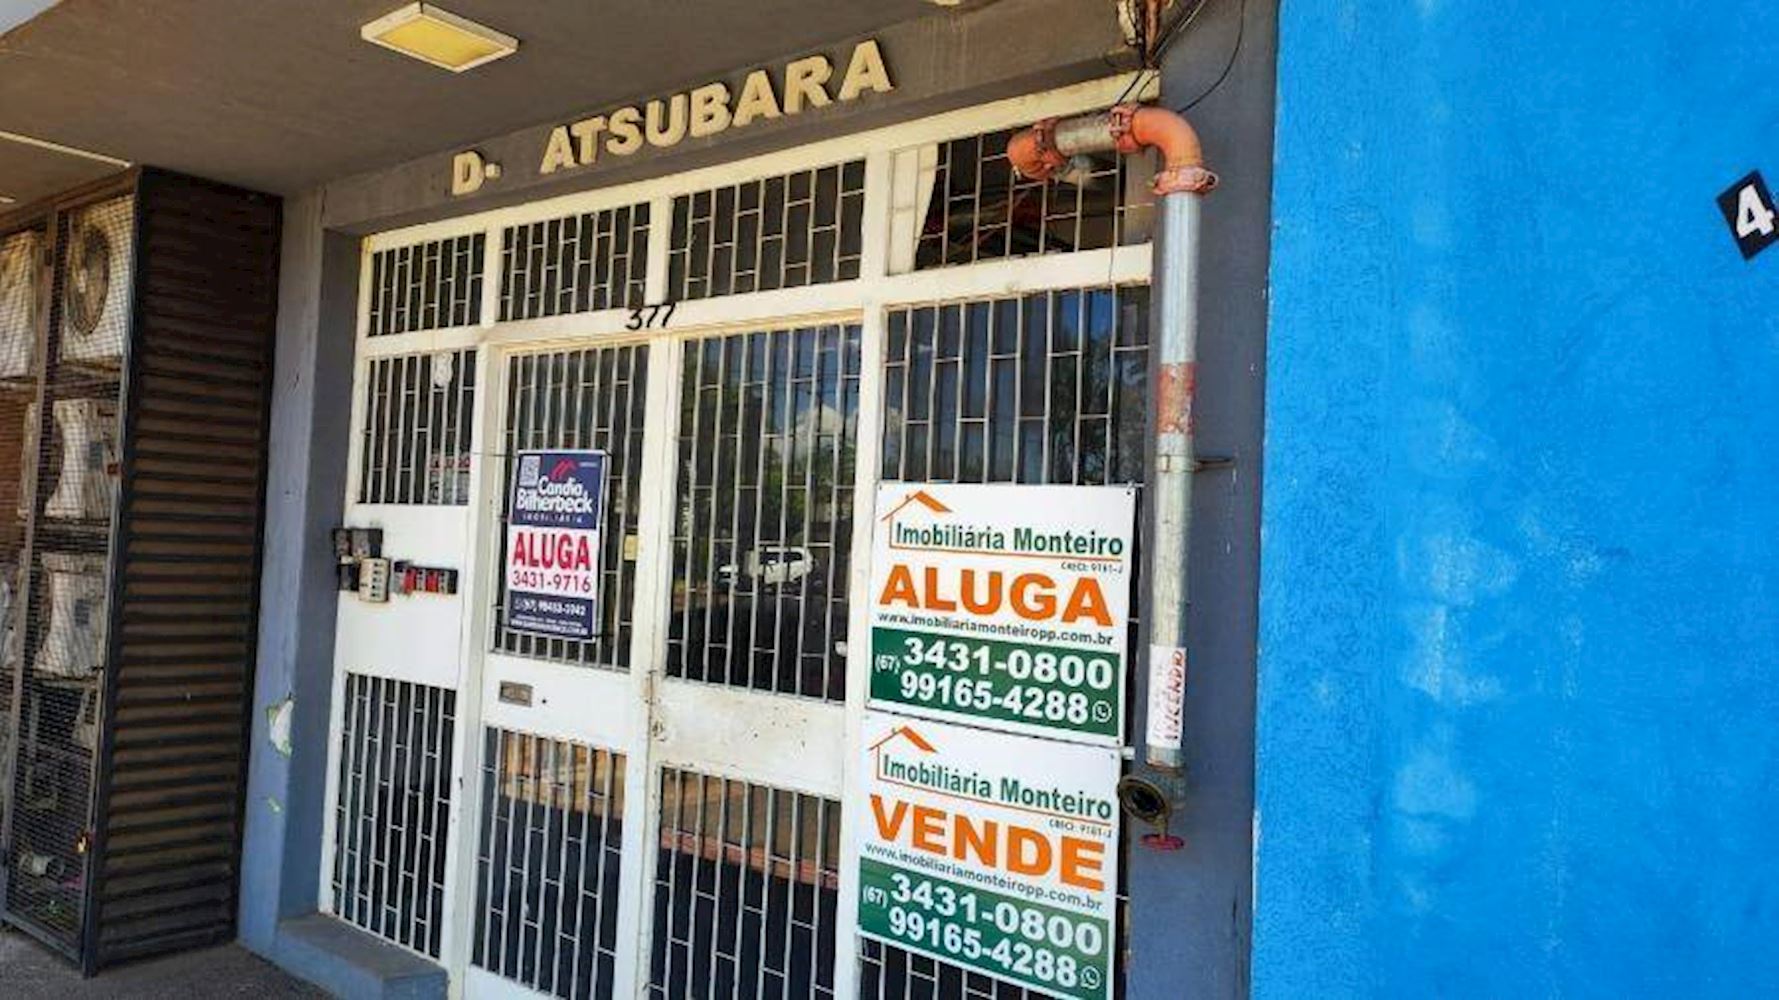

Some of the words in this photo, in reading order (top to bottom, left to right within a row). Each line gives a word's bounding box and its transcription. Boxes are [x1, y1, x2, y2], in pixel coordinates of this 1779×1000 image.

[540, 39, 894, 174] ATSUBARA
[1736, 184, 1775, 238] 4
[625, 302, 676, 330] 377
[538, 475, 583, 496] Candia
[513, 532, 591, 571] ALUGA
[896, 522, 1005, 550] Imobiliária
[1014, 527, 1123, 556] Monteiro
[512, 570, 592, 593] 3431-9716
[880, 565, 1113, 627] ALUGA
[903, 637, 1113, 690] 3431-0800
[901, 670, 1089, 724] 99165-4288
[1000, 777, 1112, 820] Monteiro
[869, 794, 1105, 891] VENDE
[863, 885, 888, 908] (67)
[891, 872, 1102, 955] 3431-0800
[888, 906, 1077, 988] 99165-4288
